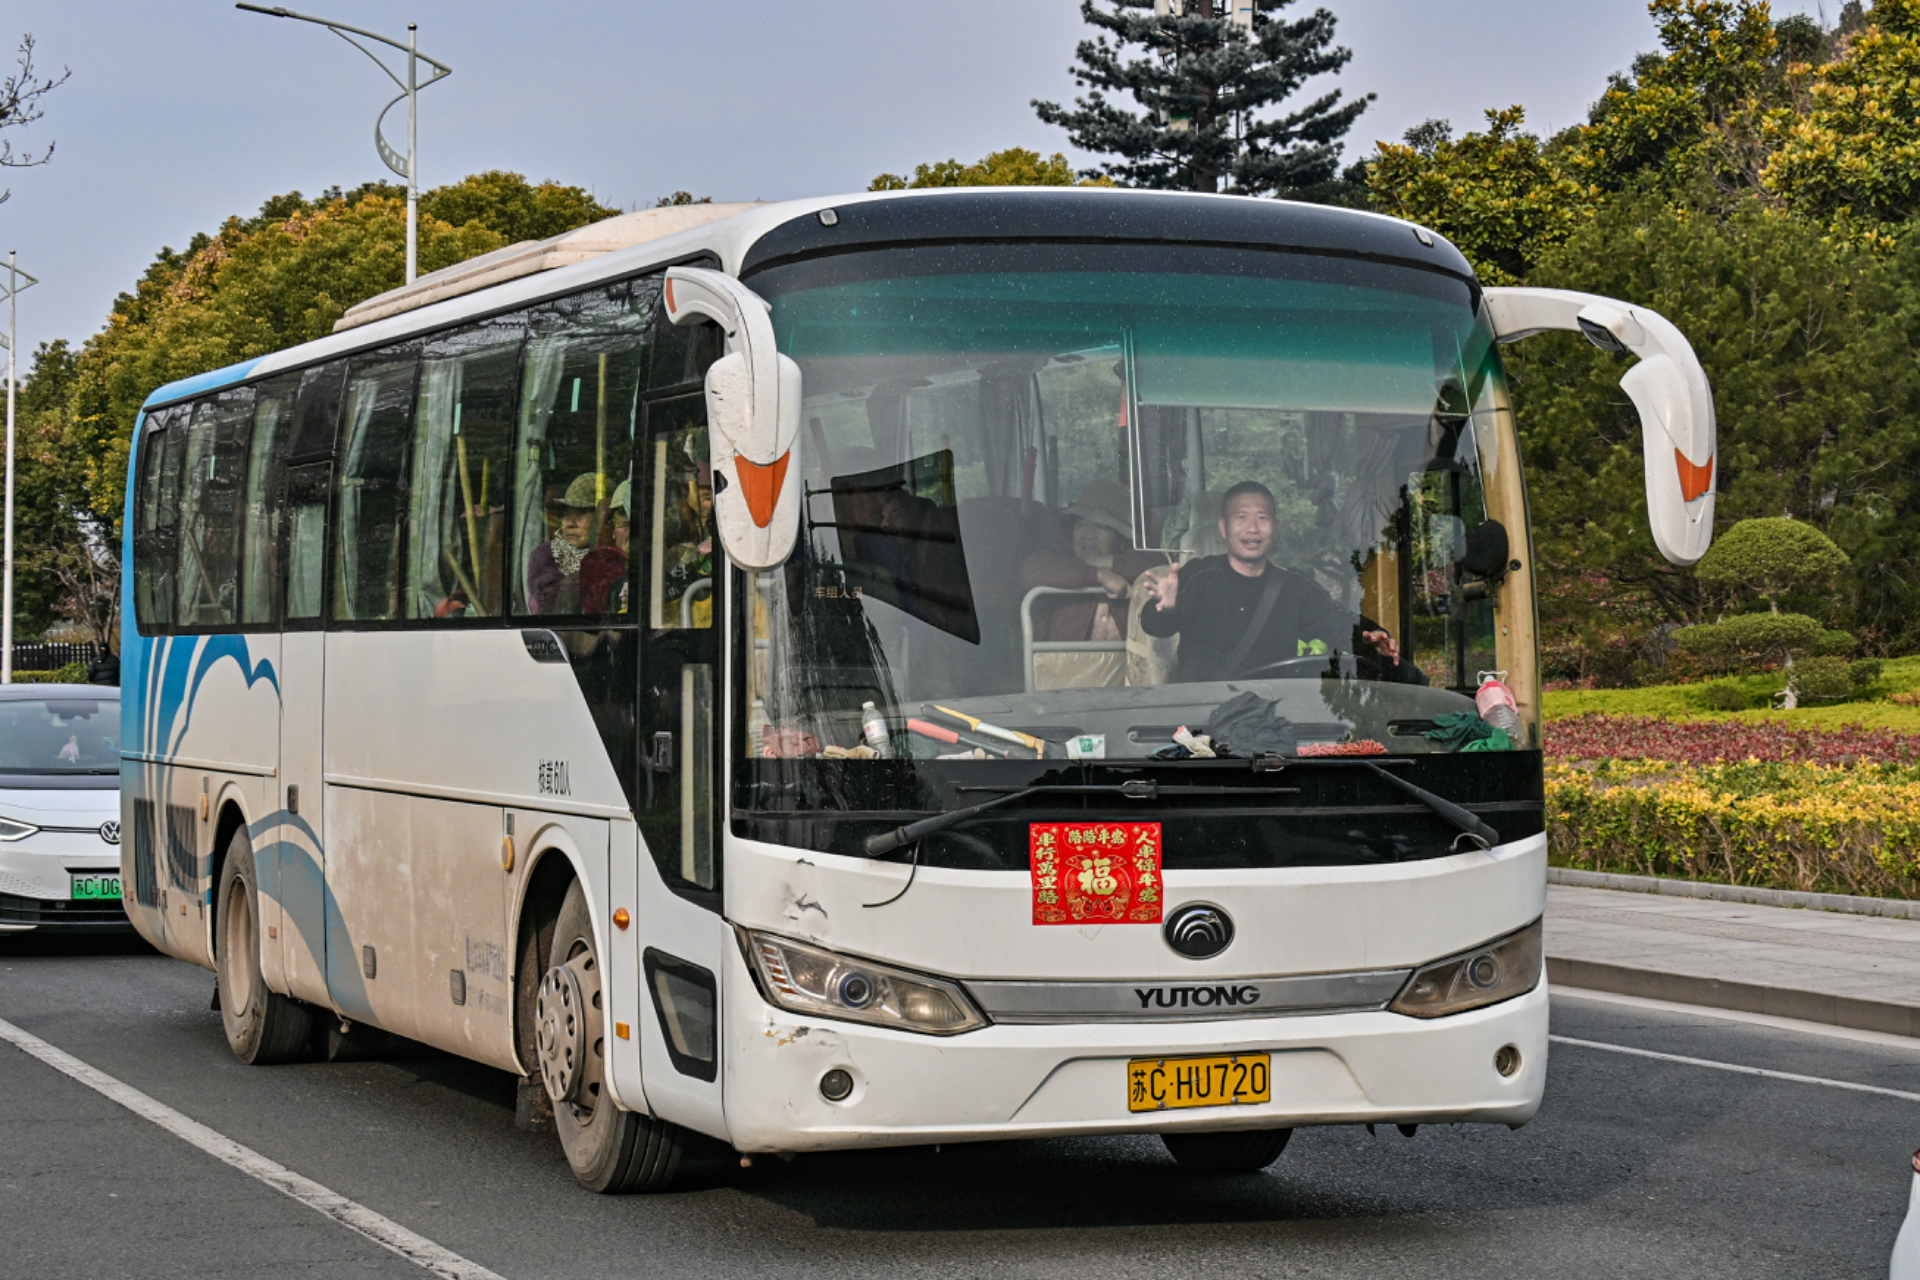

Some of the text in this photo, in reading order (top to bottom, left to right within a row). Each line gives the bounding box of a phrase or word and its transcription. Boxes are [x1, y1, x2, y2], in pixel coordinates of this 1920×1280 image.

[1068, 828, 1126, 845] 路路平安
[1077, 857, 1118, 896] 福
[1134, 985, 1261, 1009] YUTONG
[1132, 1062, 1267, 1103] 苏C·HU720
